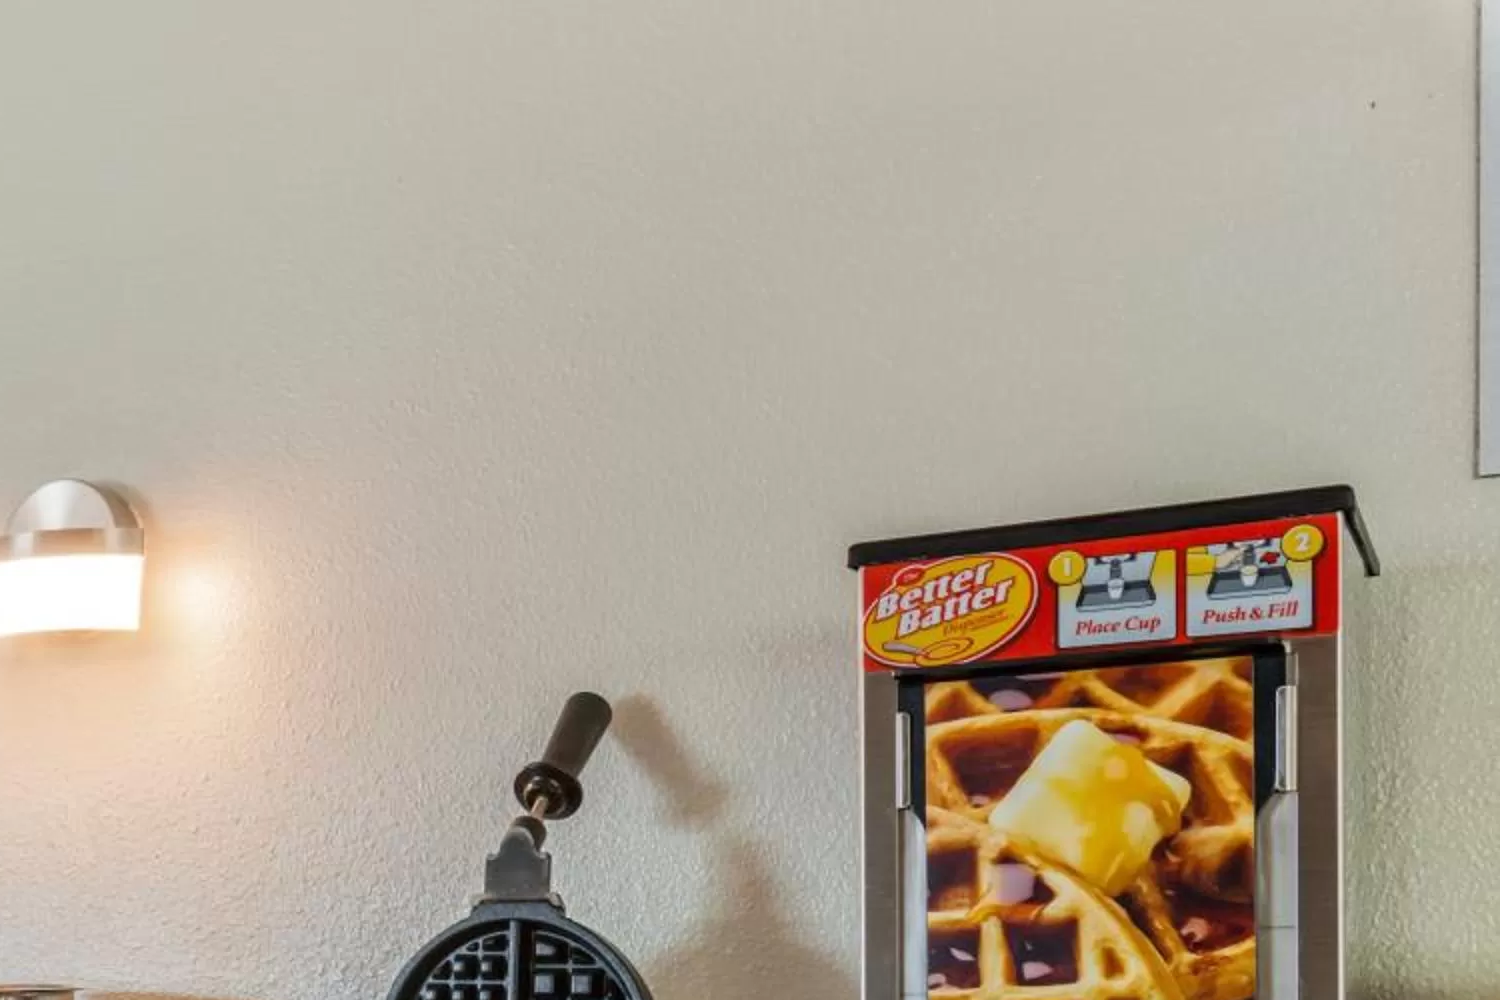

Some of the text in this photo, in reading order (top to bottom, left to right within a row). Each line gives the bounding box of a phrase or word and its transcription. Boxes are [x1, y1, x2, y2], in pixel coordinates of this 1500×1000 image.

[1295, 532, 1312, 553] 2
[875, 560, 994, 621] Better
[898, 578, 1013, 636] Batter
[1202, 600, 1299, 625] Push & Fill
[1075, 615, 1161, 636] Place Cup
